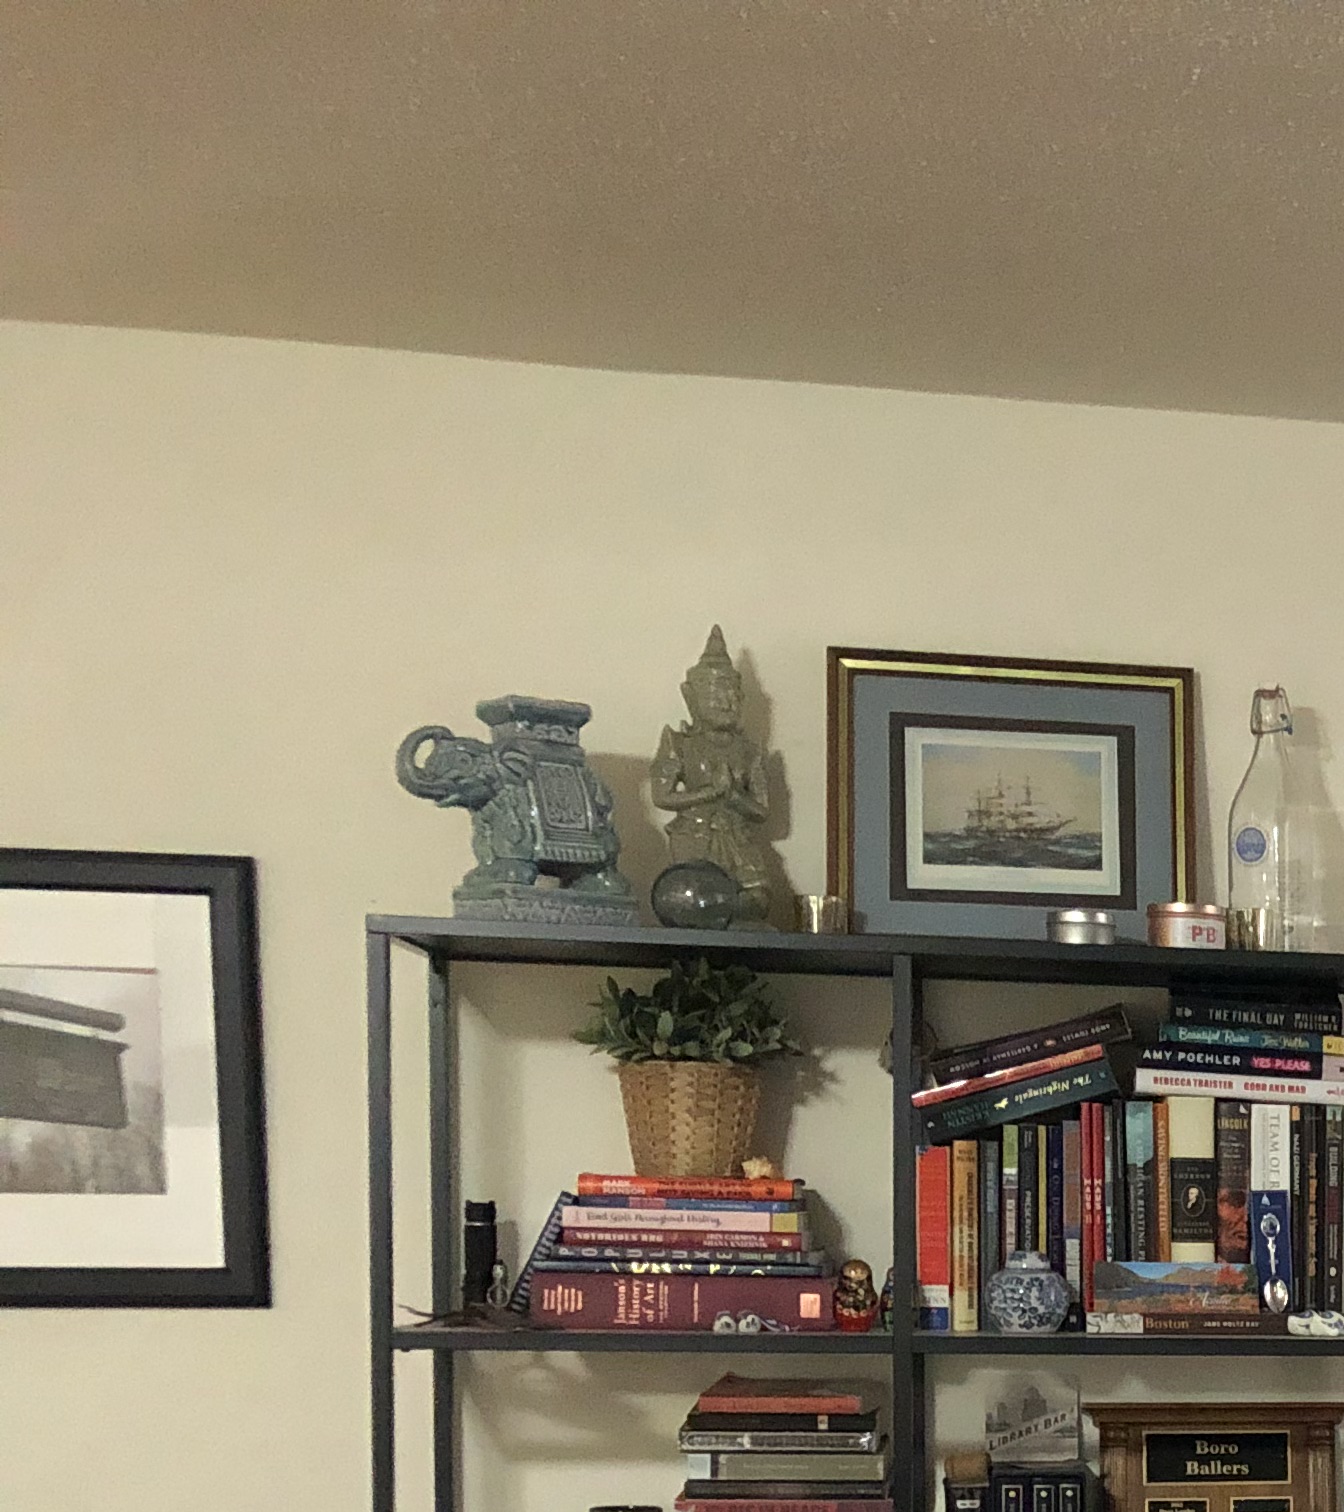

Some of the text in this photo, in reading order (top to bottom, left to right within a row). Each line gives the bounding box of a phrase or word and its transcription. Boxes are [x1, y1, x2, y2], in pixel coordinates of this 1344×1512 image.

[1208, 1009, 1285, 1026] THE FINAL DAY
[1142, 1049, 1242, 1067] AMY POEHLER
[1251, 1056, 1313, 1072] YES PLEASE
[1014, 1073, 1093, 1105] The Nightingale
[1153, 1076, 1234, 1090] REBECCA TRAISTER
[1243, 1082, 1307, 1095] GOOD AND MAD
[1268, 1113, 1281, 1148] TEAM
[1269, 1157, 1280, 1177] OF
[602, 1187, 647, 1197] MANSON
[1024, 1190, 1032, 1252] PRESERVATIO
[613, 1278, 627, 1325] Janson's
[627, 1278, 646, 1326] History
[645, 1282, 655, 1323] of Art
[1145, 1314, 1190, 1330] Boston
[988, 1412, 1067, 1451] LIBRARY BAR
[1195, 1439, 1239, 1455] Boro
[1185, 1460, 1250, 1476] Ballers
